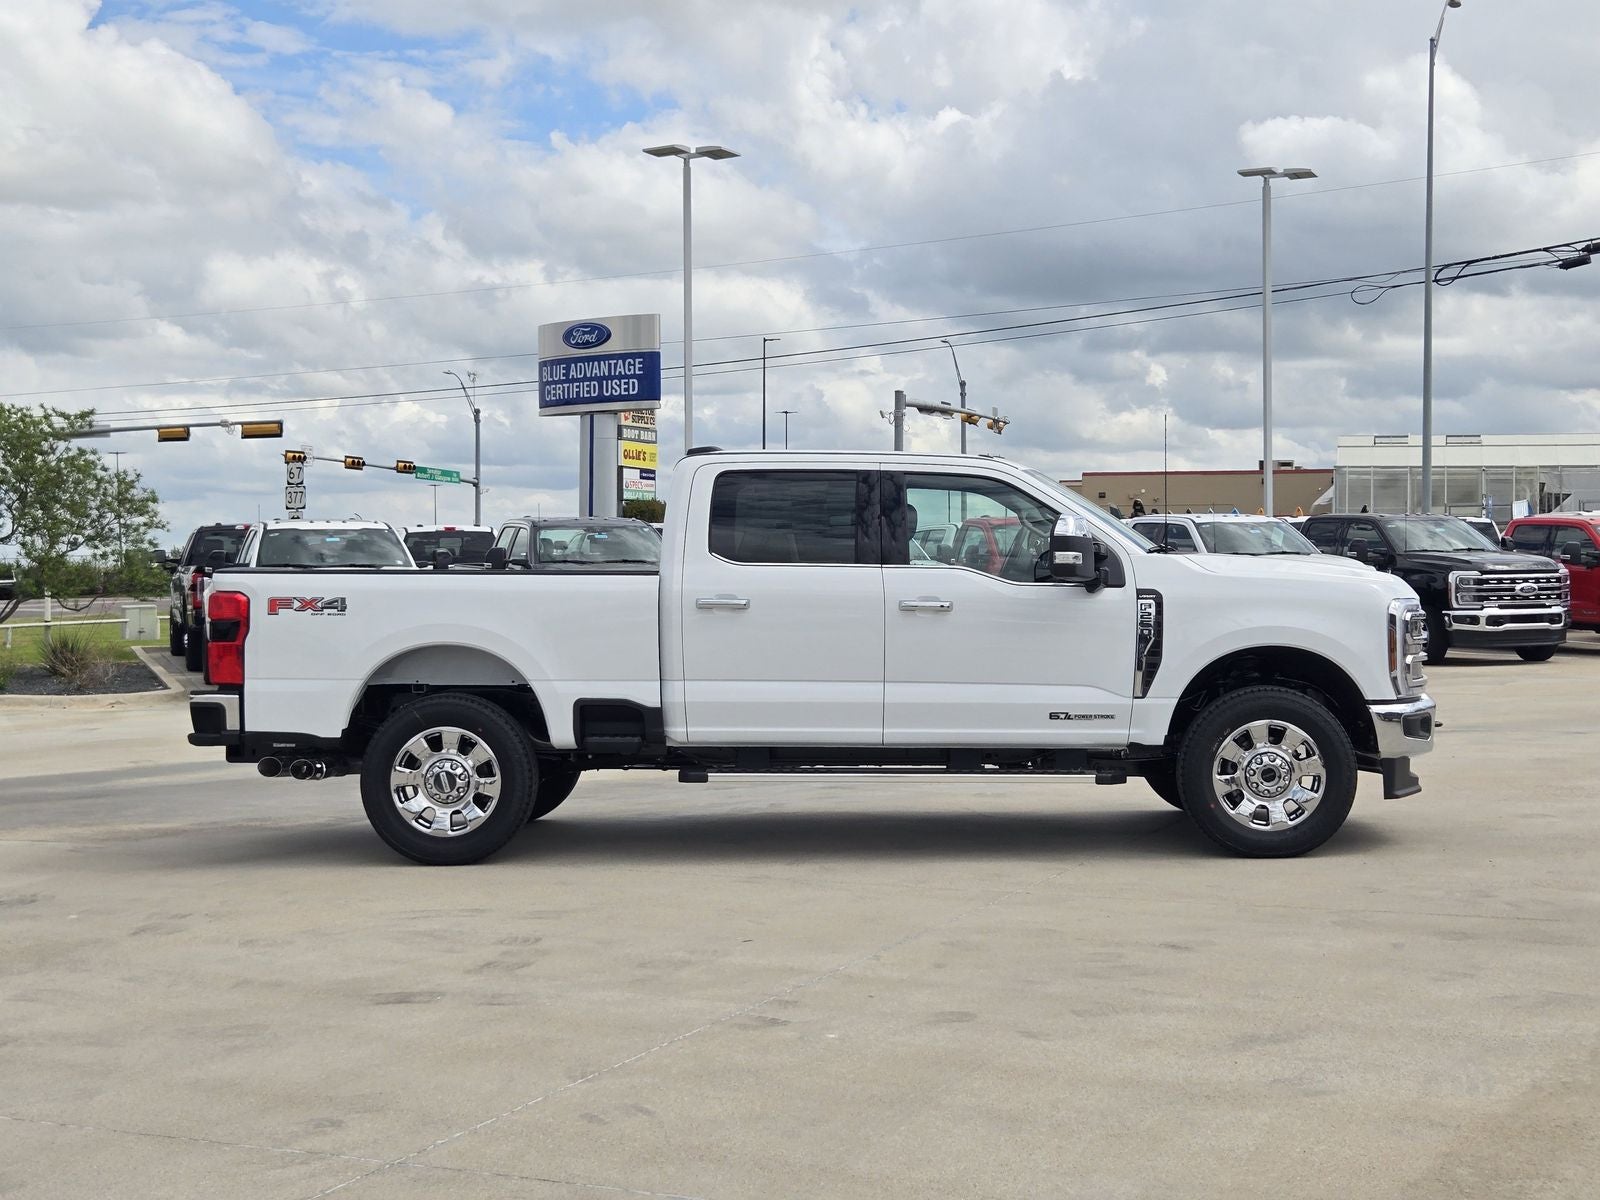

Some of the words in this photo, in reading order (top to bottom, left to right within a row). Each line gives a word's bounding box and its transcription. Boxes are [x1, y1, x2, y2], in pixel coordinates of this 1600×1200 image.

[570, 327, 598, 345] Ford
[542, 364, 566, 382] BLUE
[569, 358, 644, 380] ADVANTAGE
[545, 381, 599, 401] CERTIFIED
[603, 378, 639, 396] USED
[632, 415, 649, 424] SUPPLY
[623, 428, 639, 439] BOOT
[640, 430, 656, 441] BARN
[288, 466, 302, 480] 67
[287, 491, 304, 504] 377
[267, 596, 347, 615] FX4
[1049, 711, 1074, 721] 6.7L
